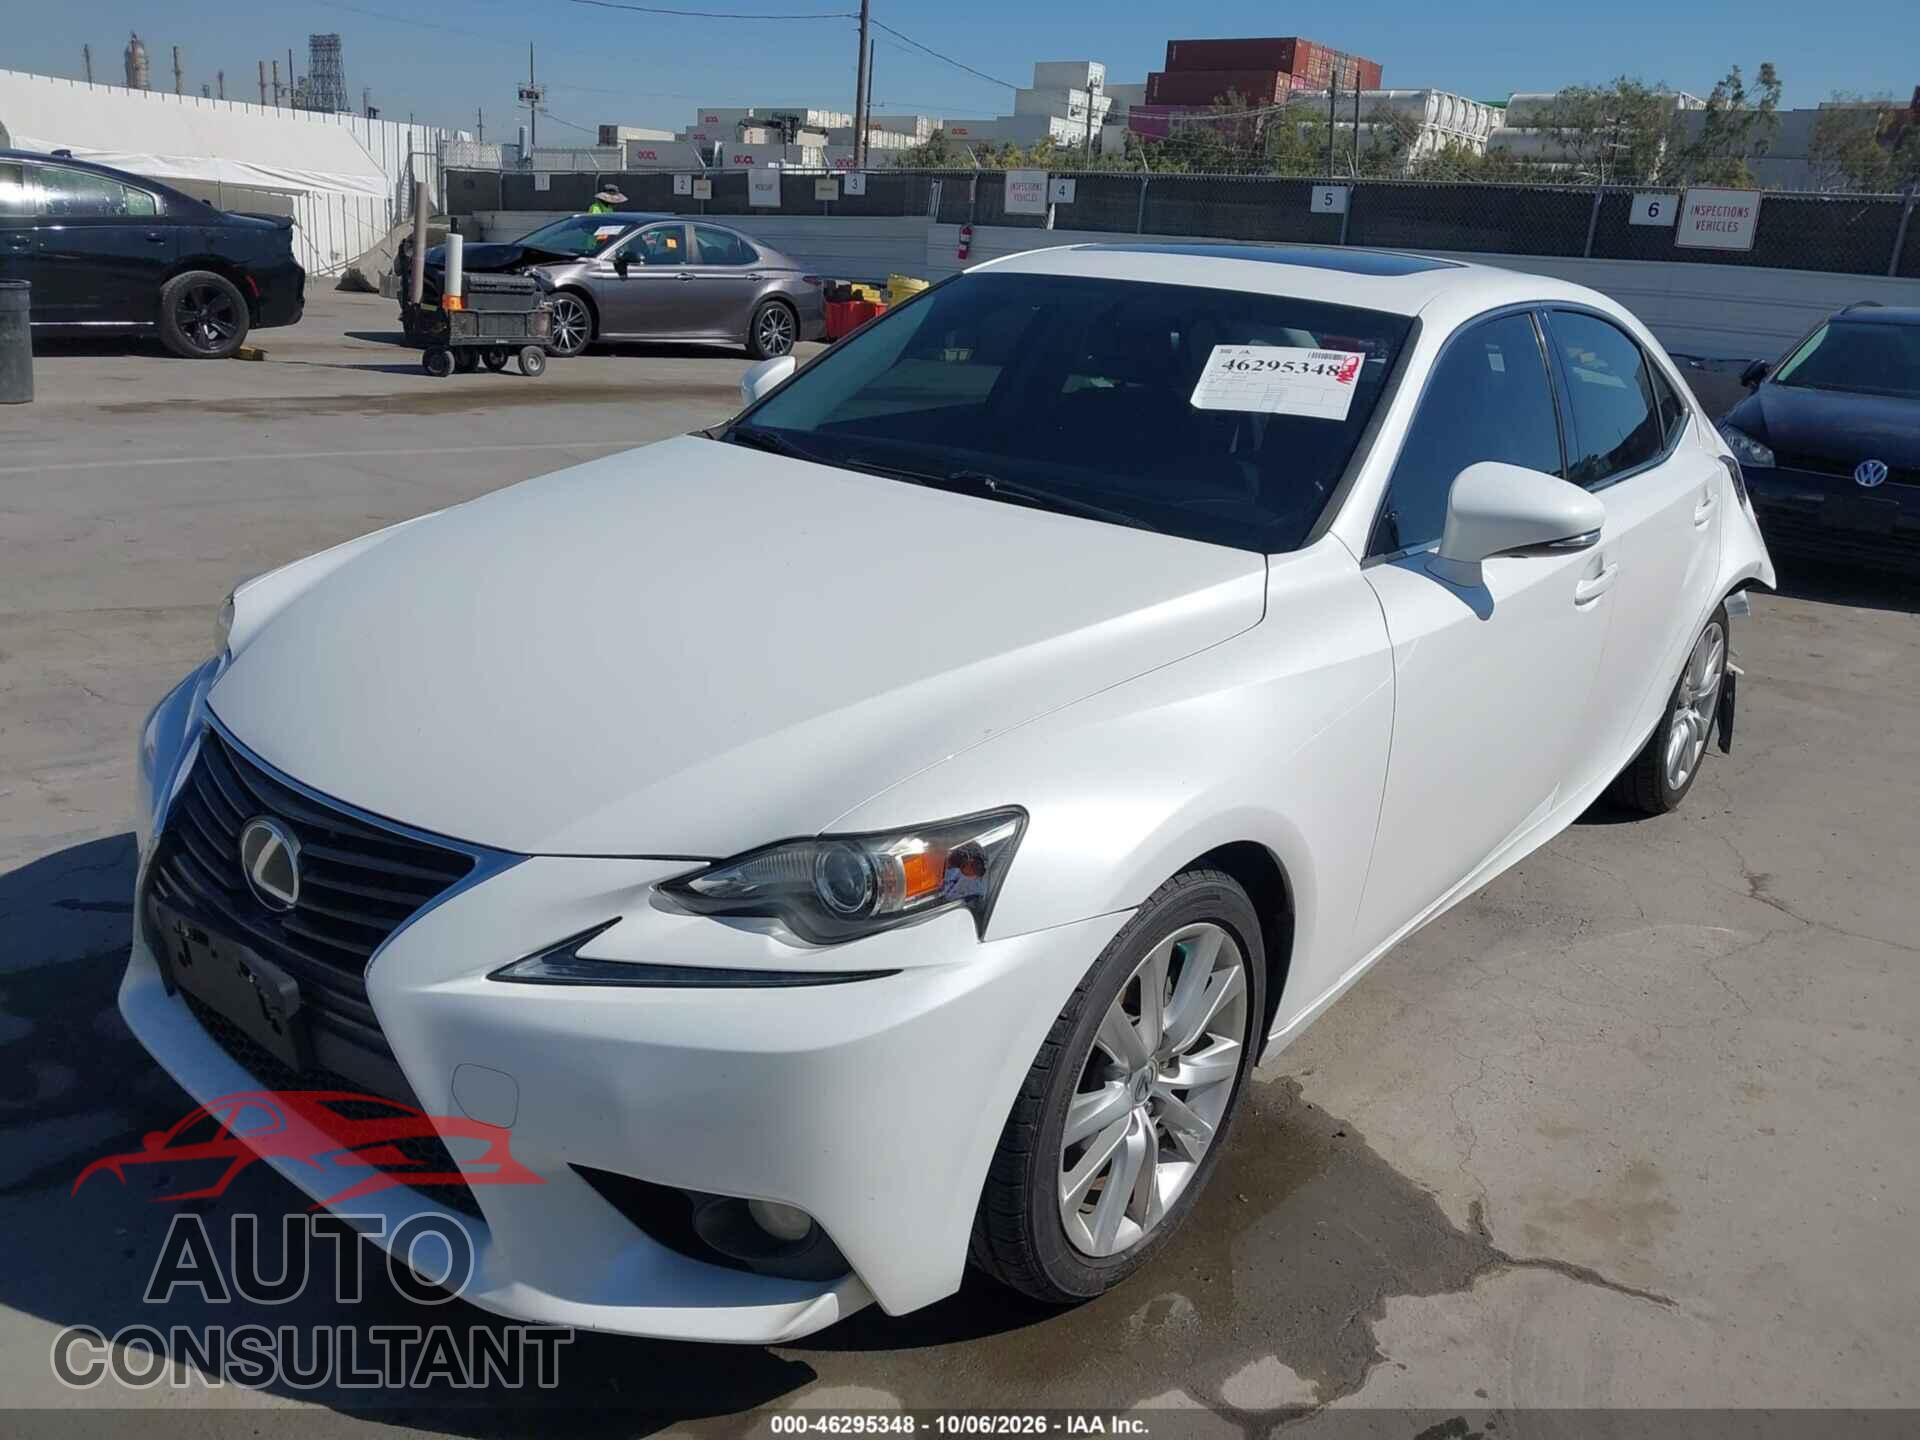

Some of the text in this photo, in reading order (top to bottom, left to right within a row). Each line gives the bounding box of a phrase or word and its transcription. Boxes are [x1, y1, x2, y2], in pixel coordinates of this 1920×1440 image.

[851, 178, 859, 190] 3
[1058, 184, 1067, 197] 4
[1324, 192, 1334, 207] 5
[1647, 202, 1660, 218] 6
[1690, 204, 1749, 218] INSPECTIONS
[1695, 219, 1739, 233] VEHICLES
[1221, 359, 1341, 377] 46295348
